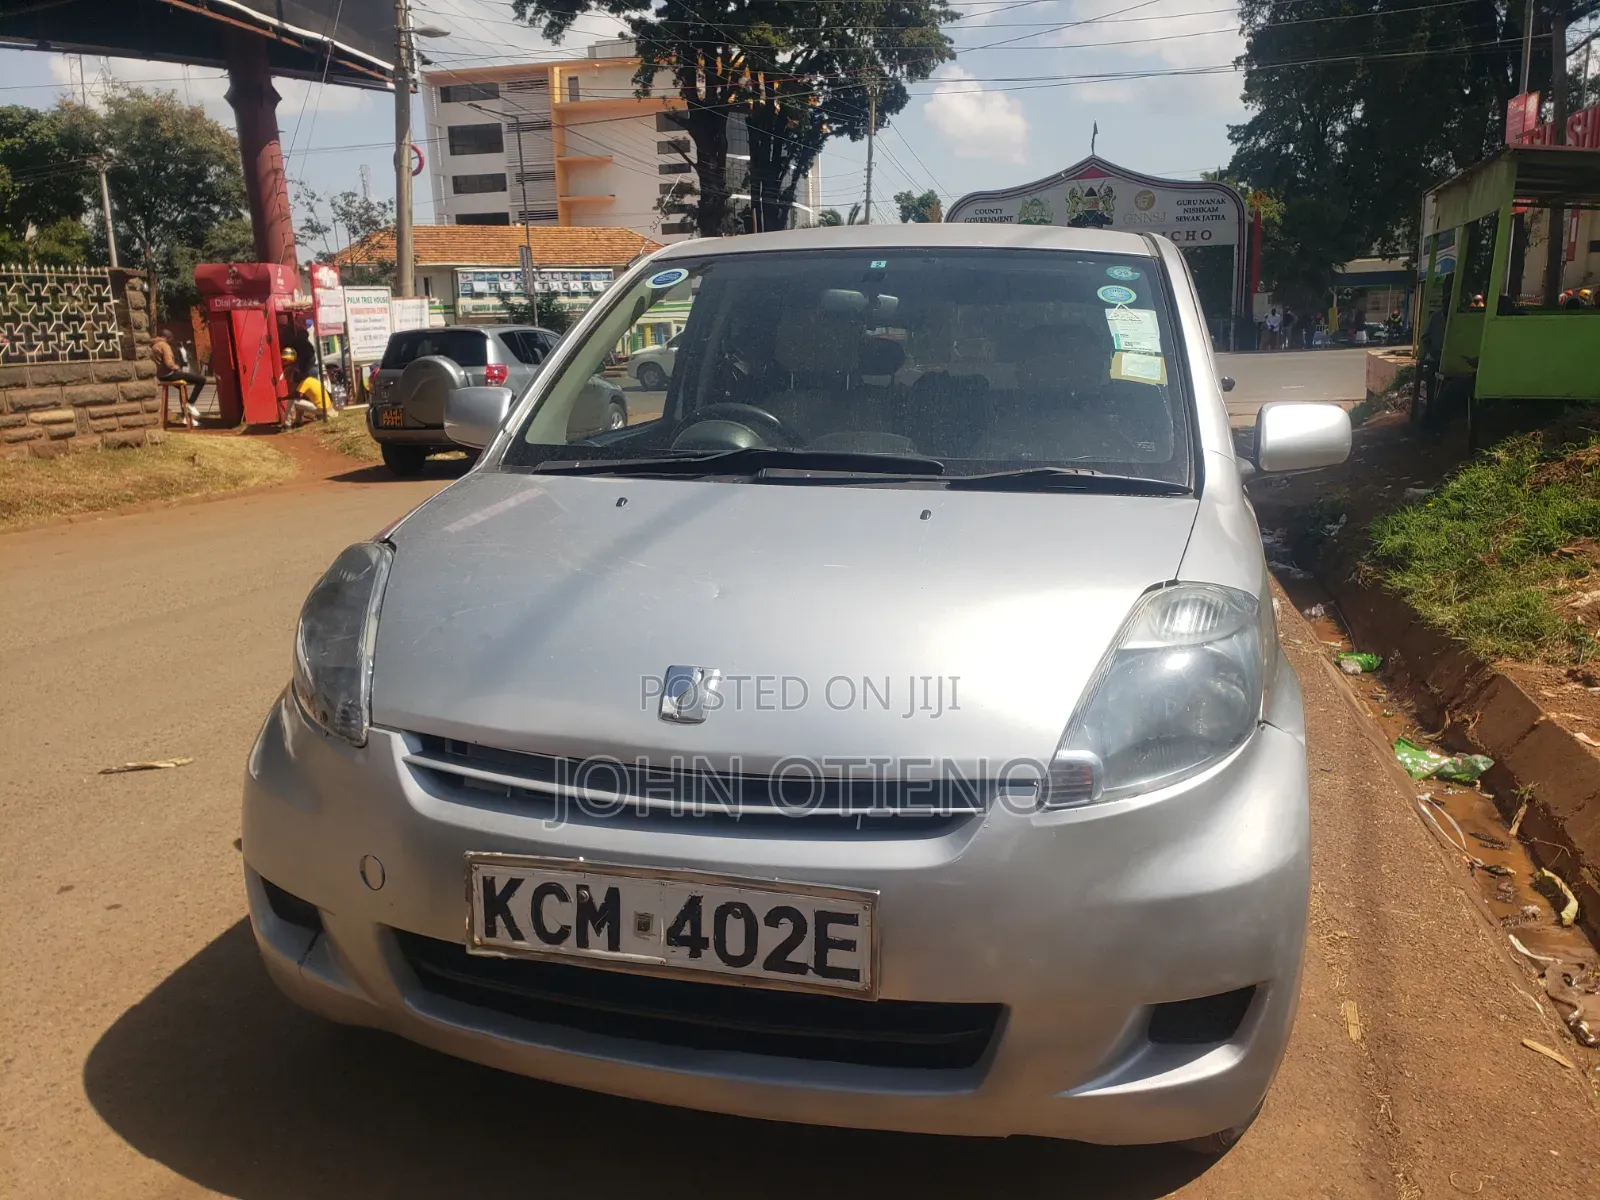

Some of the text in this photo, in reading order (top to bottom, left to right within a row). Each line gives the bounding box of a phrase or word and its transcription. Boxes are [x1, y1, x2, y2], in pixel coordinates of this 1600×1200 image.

[1176, 198, 1198, 206] GURU
[1183, 206, 1219, 214] NISHKAM
[964, 215, 1013, 223] GOVERNMENT
[1123, 212, 1166, 225] GNNSJ
[1202, 214, 1227, 222] JATHA
[489, 281, 599, 293] HEATHCARE
[214, 299, 230, 307] Dial
[374, 296, 389, 304] HOUSE
[482, 875, 861, 983] KCM 402E
